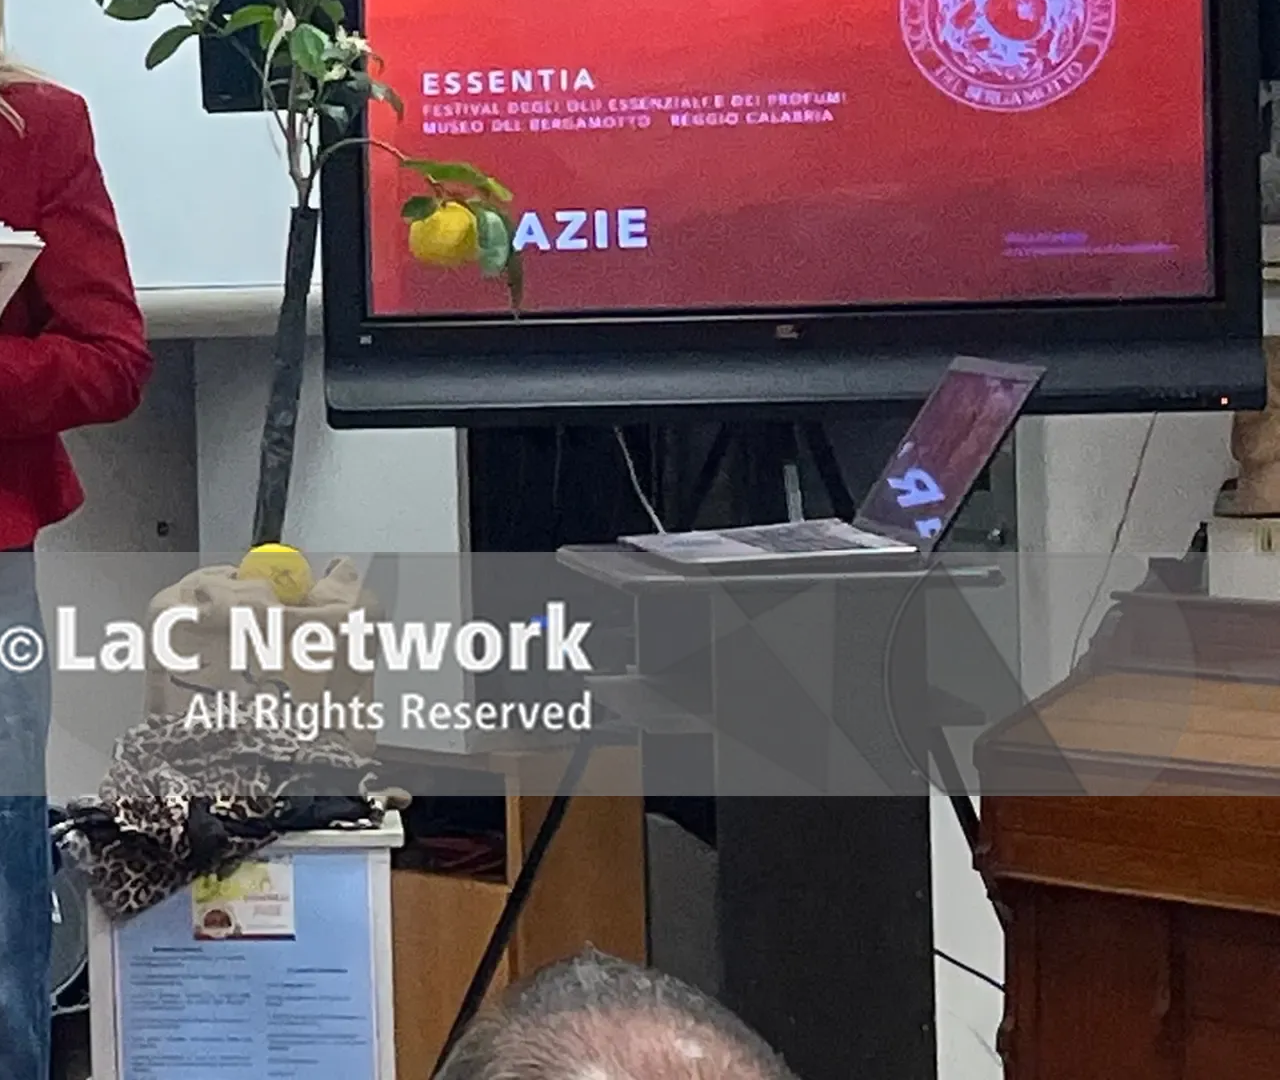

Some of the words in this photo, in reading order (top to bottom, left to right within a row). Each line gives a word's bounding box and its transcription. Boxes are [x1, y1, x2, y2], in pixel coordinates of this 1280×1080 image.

[421, 67, 597, 97] ESSENTIA
[422, 101, 500, 118] FESTIVAL
[507, 99, 560, 115] DEGLI
[730, 93, 761, 108] DEI
[767, 91, 848, 106] PROFUMI
[422, 119, 485, 135] MUSEO
[491, 118, 522, 133] DEL
[529, 114, 652, 132] BERGAMOTTO
[669, 111, 740, 128] REGGIO
[744, 107, 835, 125] CALABRIA
[510, 207, 650, 253] AZIE
